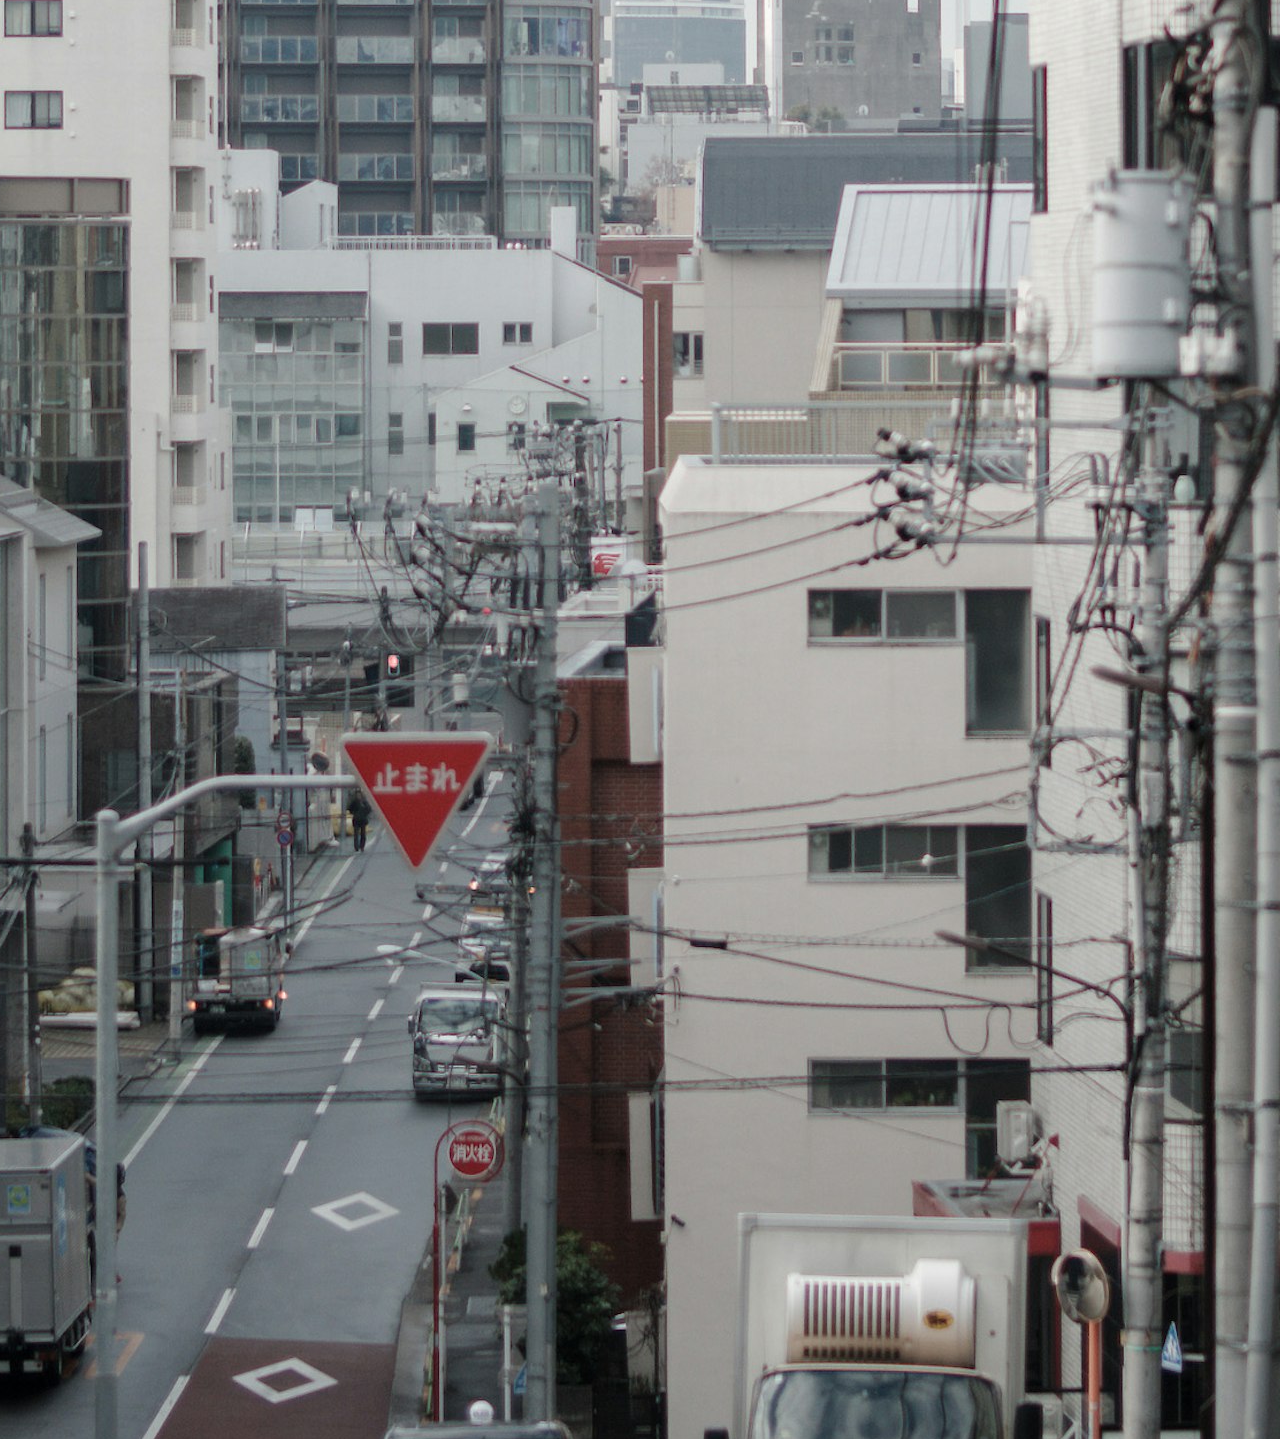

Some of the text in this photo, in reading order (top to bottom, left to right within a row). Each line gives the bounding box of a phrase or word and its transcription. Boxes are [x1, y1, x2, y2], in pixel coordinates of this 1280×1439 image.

[372, 762, 461, 795] 止まれ
[452, 1143, 491, 1162] 消火栓
